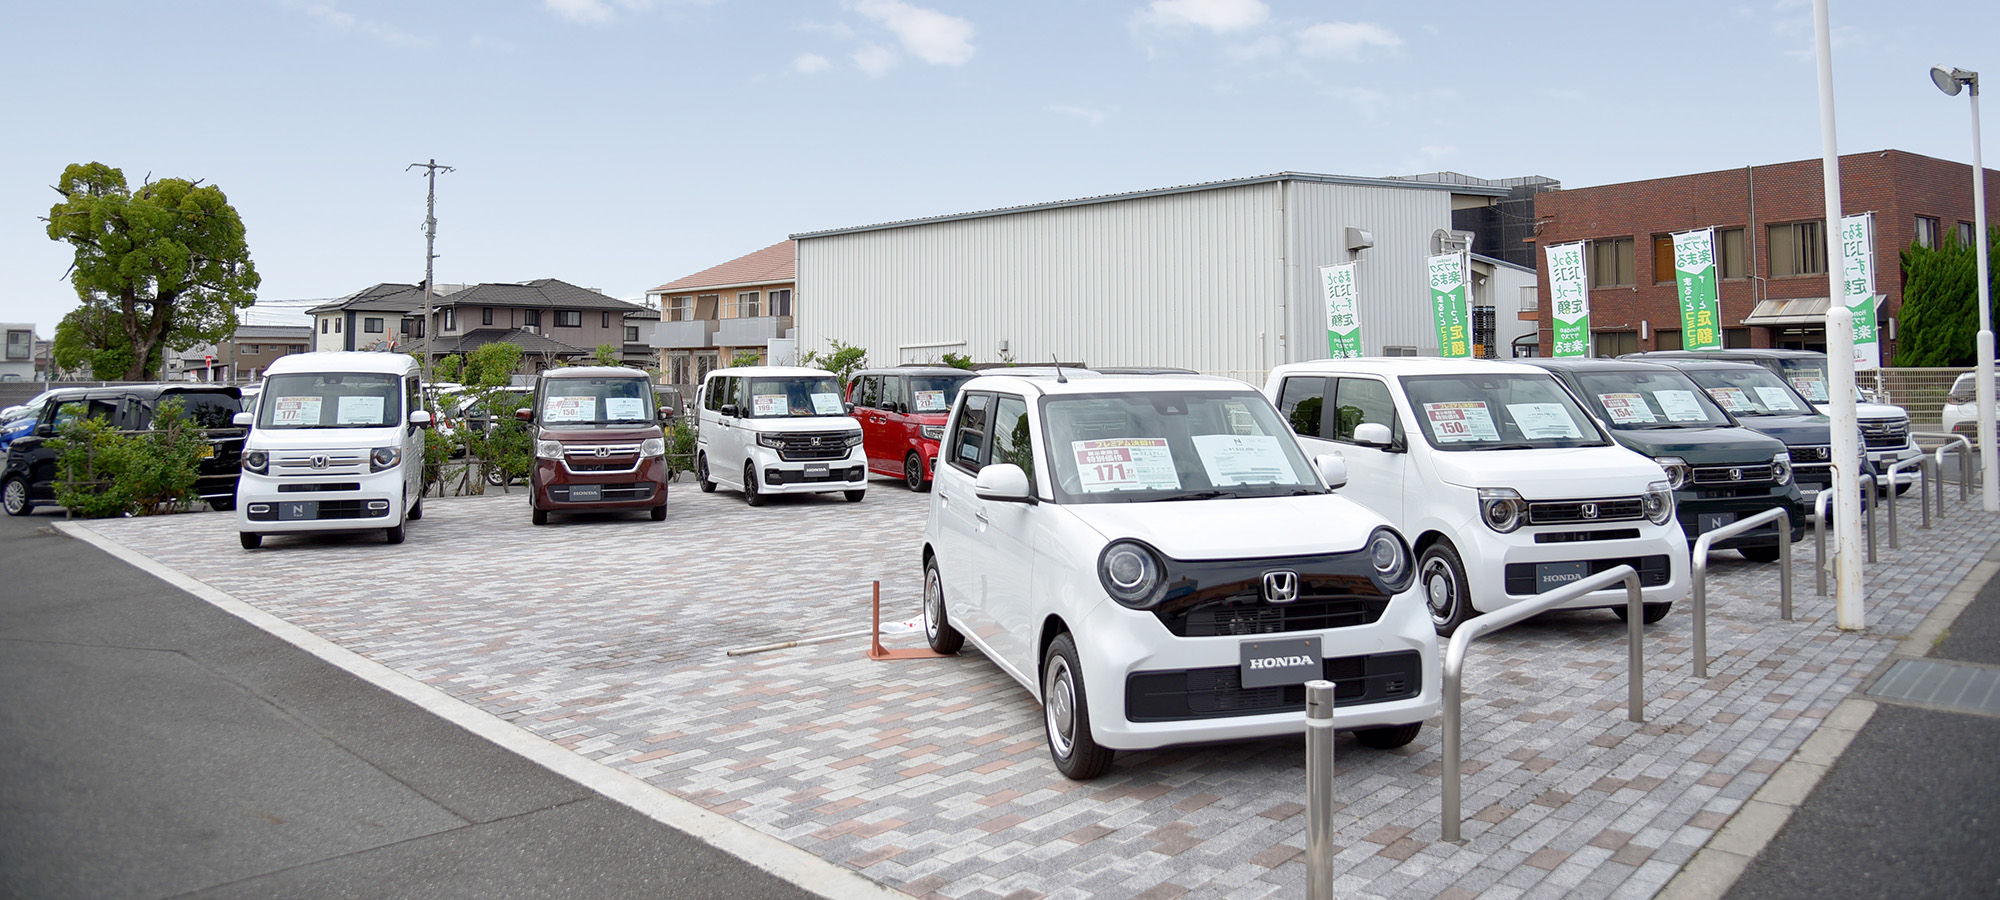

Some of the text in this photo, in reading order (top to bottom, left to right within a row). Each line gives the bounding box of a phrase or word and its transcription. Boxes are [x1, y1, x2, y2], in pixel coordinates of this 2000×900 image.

[281, 410, 297, 419] 177
[562, 408, 575, 416] 150
[1613, 408, 1632, 418] 154
[1439, 421, 1464, 434] 150
[1086, 454, 1124, 464] 特別価格
[1093, 463, 1127, 482] 171
[293, 504, 303, 514] N
[1711, 517, 1722, 528] N
[1543, 573, 1582, 583] HONDA
[1249, 655, 1315, 669] HONDA
